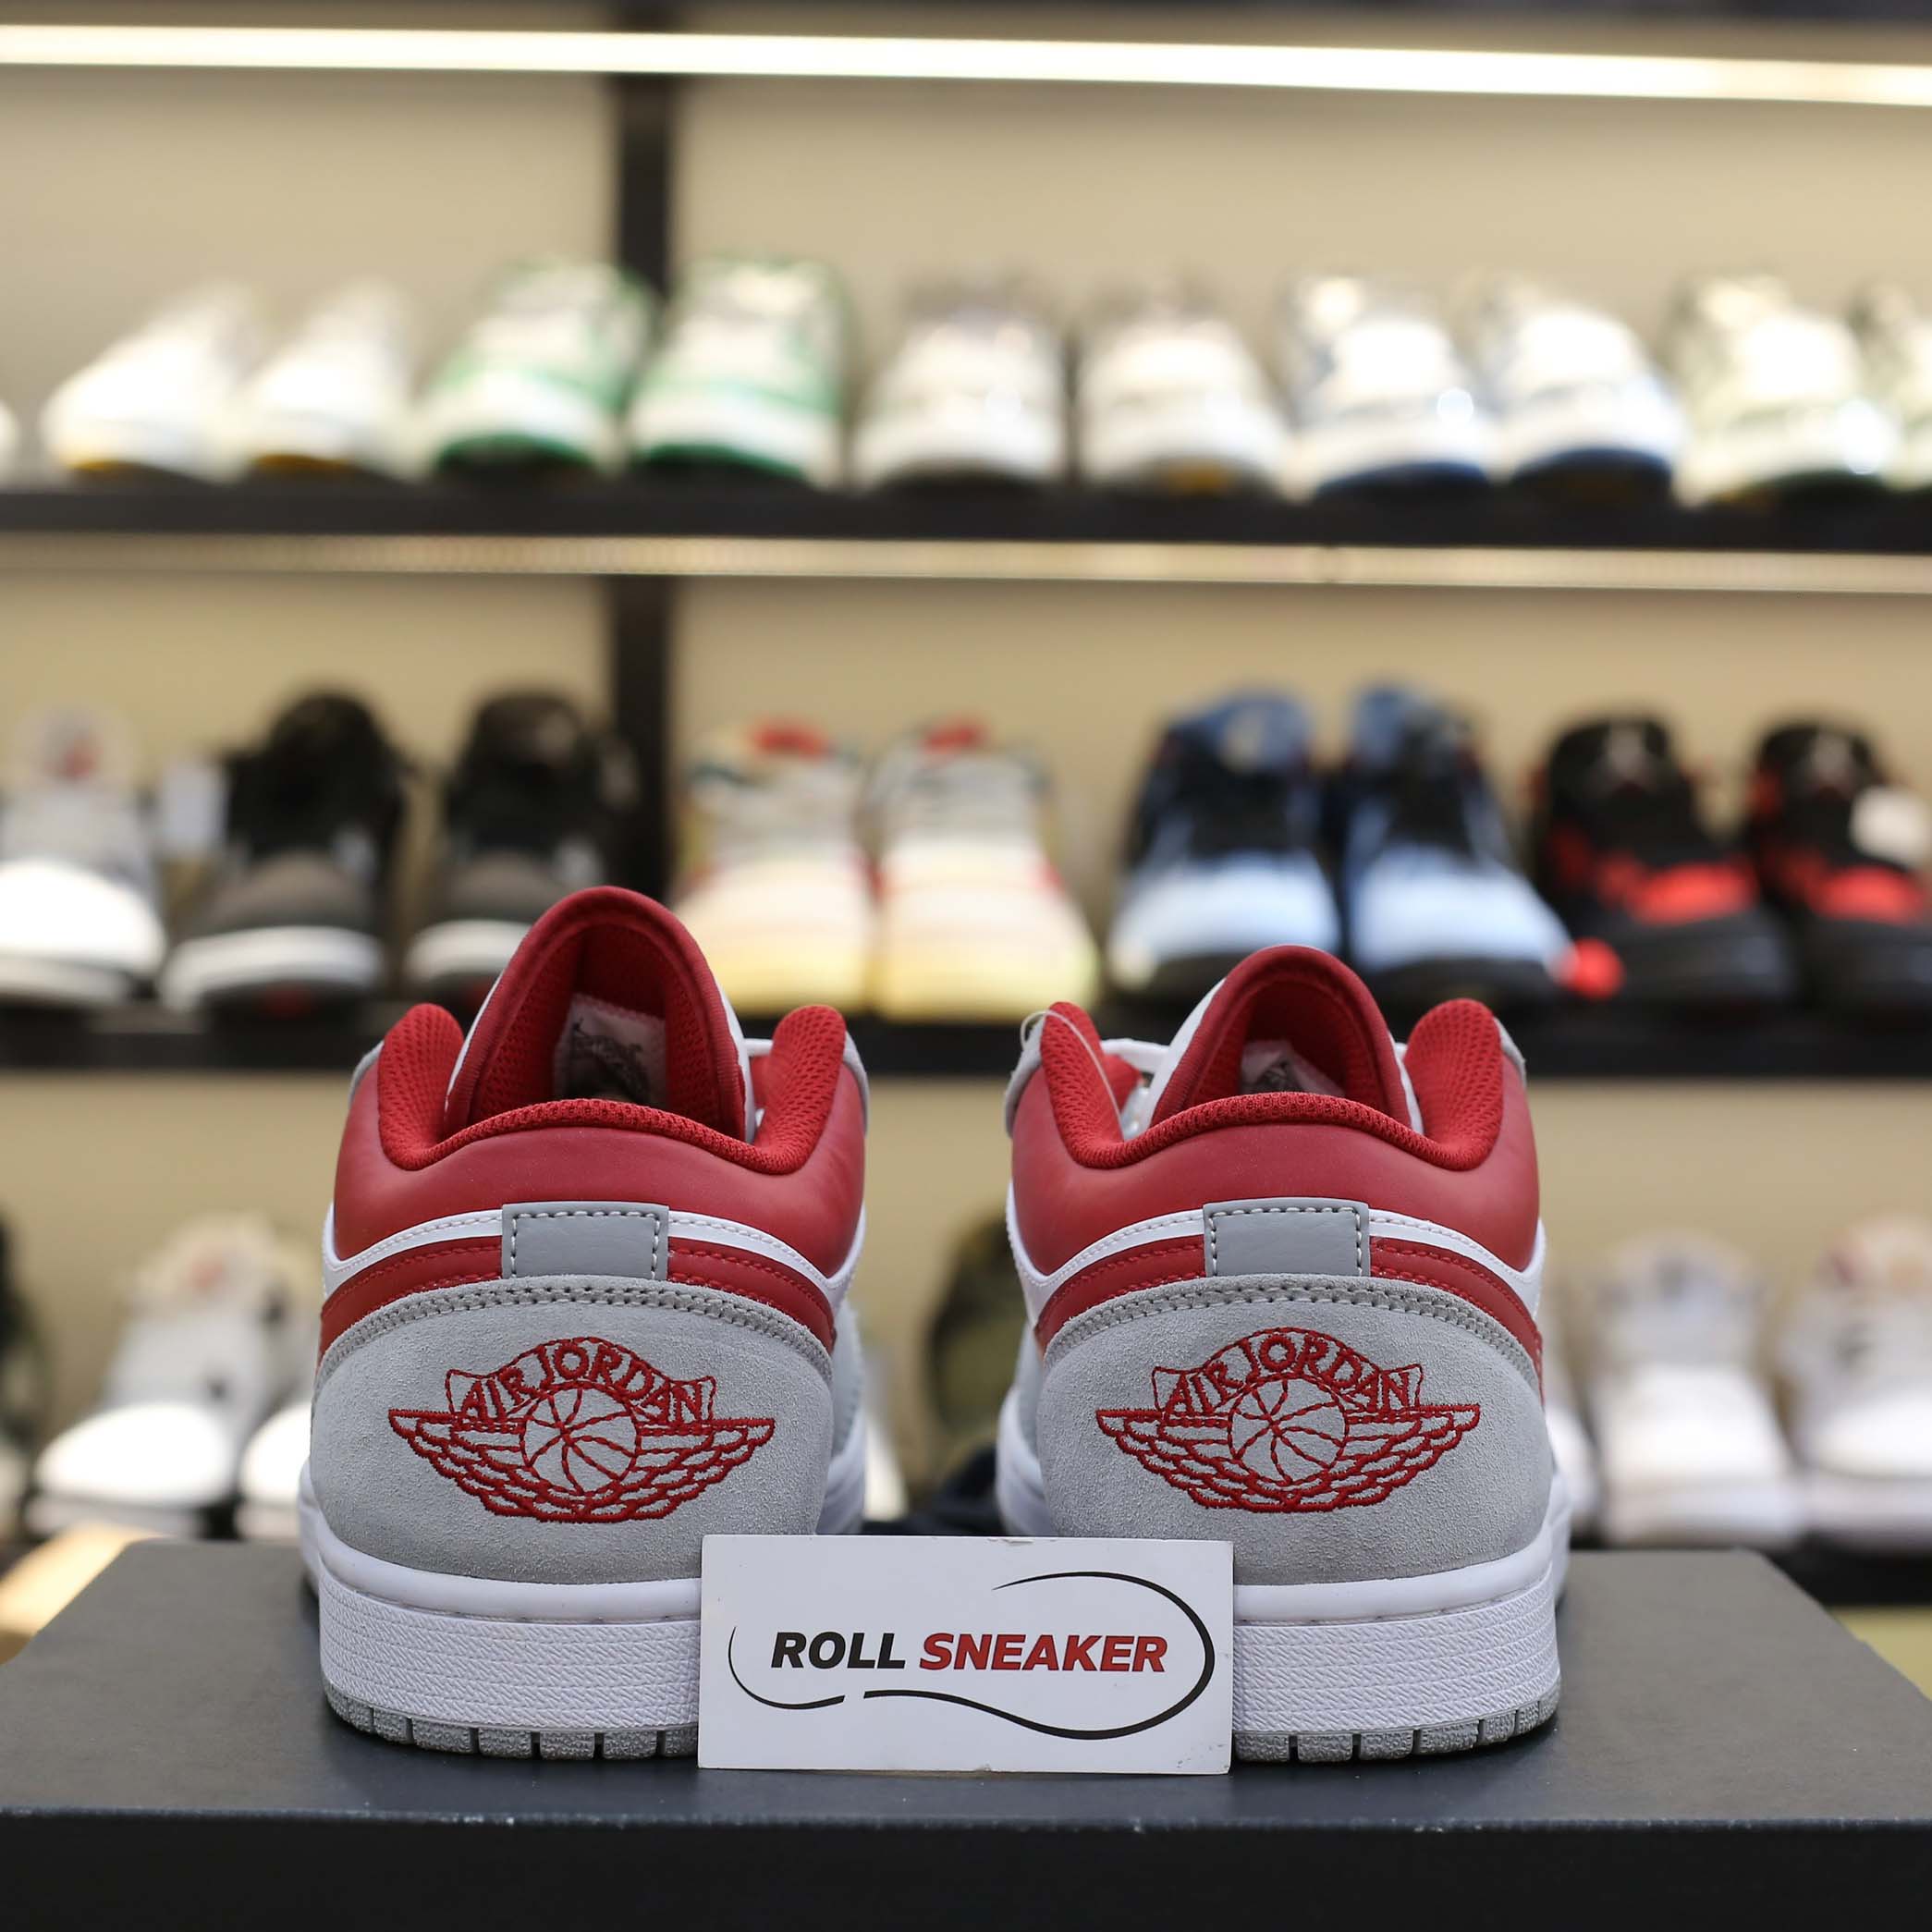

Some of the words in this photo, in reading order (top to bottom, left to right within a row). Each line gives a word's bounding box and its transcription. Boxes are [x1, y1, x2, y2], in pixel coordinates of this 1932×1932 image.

[459, 1366, 542, 1423] AIR
[534, 1342, 703, 1423] JORDAN
[1165, 1360, 1245, 1413] AIR
[1238, 1333, 1410, 1412] JORDAN
[771, 1632, 906, 1669] ROLL
[920, 1633, 1168, 1672] SNEAKER
